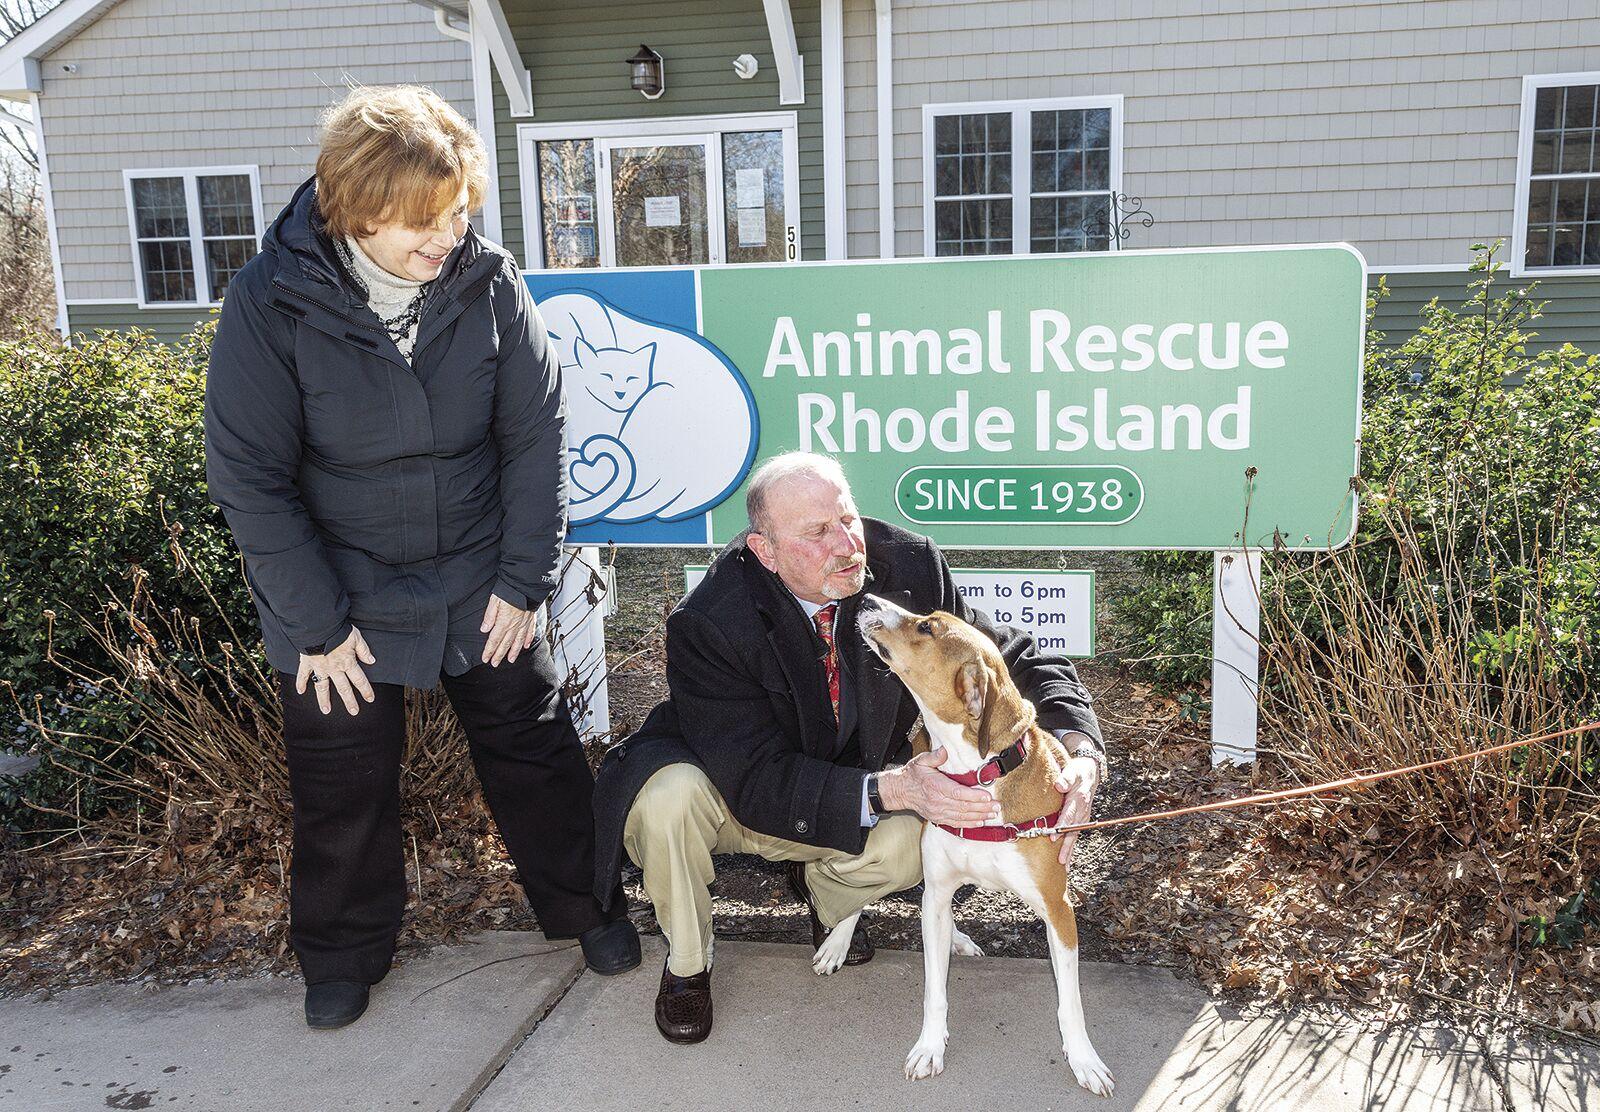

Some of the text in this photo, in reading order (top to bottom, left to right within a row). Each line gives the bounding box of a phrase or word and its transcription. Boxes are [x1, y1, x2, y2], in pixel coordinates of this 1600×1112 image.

[787, 226, 796, 260] 50
[762, 308, 1290, 378] Animal Rescue
[797, 384, 1252, 454] Rhode Island
[914, 478, 1124, 514] SINCE 1938
[994, 583, 1013, 598] to
[994, 608, 1013, 623] to
